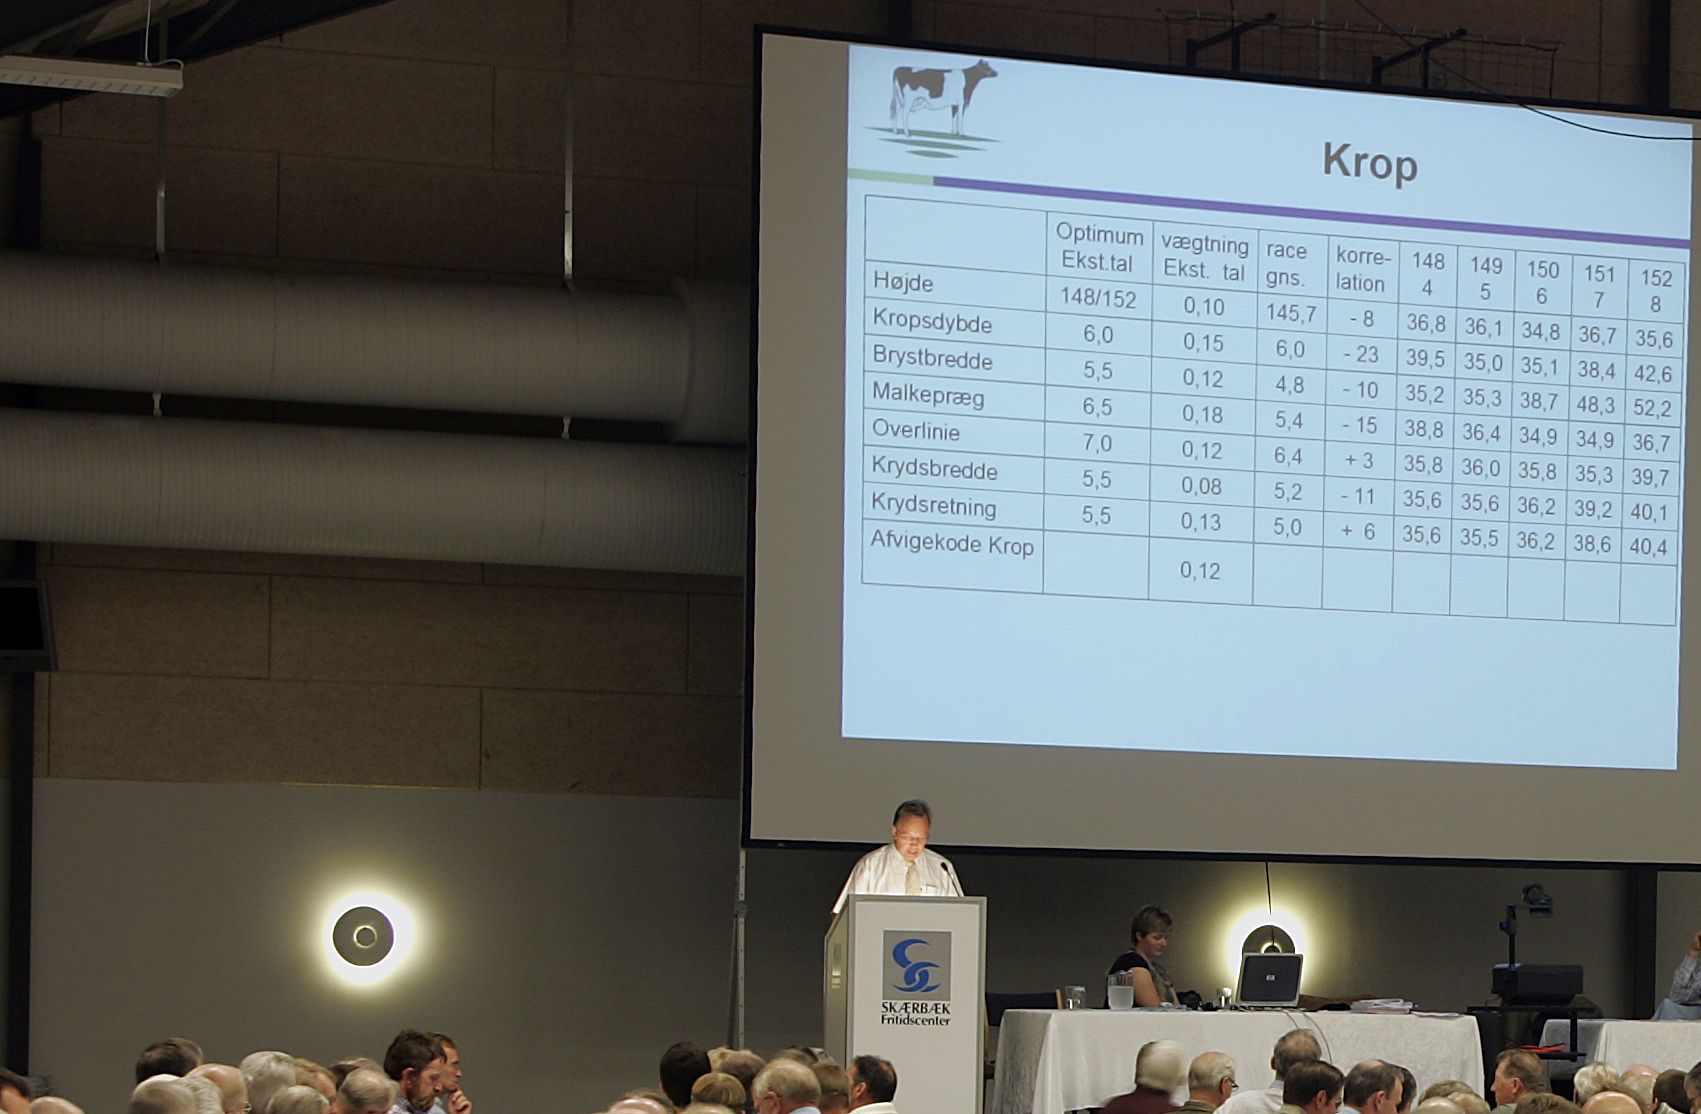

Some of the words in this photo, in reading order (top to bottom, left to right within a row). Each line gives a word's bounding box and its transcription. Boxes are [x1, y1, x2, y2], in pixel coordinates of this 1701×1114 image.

[1323, 141, 1418, 190] Krop
[1056, 221, 1144, 247] Optimum
[1161, 234, 1249, 260] vægtning
[1267, 243, 1308, 260] race
[1336, 244, 1392, 266] korre-
[1413, 251, 1445, 271] 148
[1471, 256, 1503, 275] 149
[1527, 260, 1560, 279] 150
[1584, 264, 1614, 283] 151
[1641, 268, 1673, 288] 152
[1164, 257, 1210, 280] Ekst.
[1222, 263, 1245, 282] tal
[1265, 270, 1305, 289] gns.
[1336, 271, 1385, 293] lation
[1421, 278, 1433, 297] 4
[1480, 282, 1491, 301] 5
[1536, 287, 1548, 305] 6
[1594, 290, 1605, 309] 7
[1650, 295, 1662, 313] 8
[874, 269, 934, 296] Højde
[1061, 286, 1137, 310] 148/152
[1183, 295, 1225, 317] 0,10
[1266, 302, 1317, 325] 145,7
[1362, 309, 1375, 328] 8
[1407, 312, 1446, 335] 36,8
[1464, 316, 1502, 339] 36,1
[1522, 320, 1561, 343] 34,8
[1578, 325, 1617, 347] 36,7
[1635, 329, 1674, 351] 35,6
[873, 306, 993, 336] Kropsdybde
[1083, 323, 1114, 346] 6,0
[1183, 331, 1224, 353] 0,15
[1276, 339, 1305, 361] 6,0
[1356, 344, 1379, 364] 23
[1406, 348, 1446, 370] 39,5
[1464, 352, 1504, 374] 35,0
[1521, 356, 1557, 378] 35,1
[1578, 360, 1617, 382] 38,4
[1634, 364, 1673, 385] 42,6
[873, 343, 993, 371] Brystbredde
[1083, 360, 1113, 382] 5,5
[1182, 367, 1224, 390] 0,12
[1275, 375, 1305, 396] 4,8
[1357, 380, 1379, 399] 10
[1405, 383, 1445, 406] 35,2
[1463, 387, 1502, 409] 35,3
[1520, 391, 1559, 413] 38,7
[1576, 395, 1615, 417] 48,3
[1633, 398, 1672, 420] 52,2
[873, 380, 985, 412] Malkepræg
[1082, 396, 1113, 419] 6,5
[1182, 403, 1223, 425] 0,18
[1275, 410, 1303, 432] 5,4
[1357, 416, 1378, 435] 15
[1404, 418, 1444, 441] 38,8
[1462, 422, 1501, 444] 36,4
[1519, 425, 1558, 448] 34,9
[1576, 429, 1615, 451] 34,9
[1632, 433, 1671, 454] 36,7
[872, 417, 961, 442] Overlinie
[1083, 432, 1113, 455] 7,0
[1182, 440, 1222, 461] 0,12
[1274, 446, 1303, 467] 6,4
[1362, 451, 1374, 470] 3
[1403, 454, 1443, 476] 35,8
[1461, 457, 1501, 480] 36,0
[1518, 460, 1557, 482] 35,8
[1575, 464, 1614, 486] 35,3
[1631, 467, 1670, 489] 39,7
[872, 454, 999, 481] Krydsbredde
[1082, 469, 1112, 491] 5,5
[1181, 475, 1222, 497] 0,08
[1274, 481, 1303, 503] 5,2
[1356, 486, 1374, 505] 11
[1402, 489, 1442, 511] 35,6
[1460, 492, 1500, 514] 35,6
[1517, 495, 1556, 517] 36,2
[1574, 499, 1613, 521] 39,2
[1630, 502, 1667, 523] 40,1
[870, 528, 982, 554] Afvigekode
[988, 535, 1035, 561] Krop
[1180, 560, 1221, 582] 0,12
[872, 491, 997, 522] Krydsretning
[1082, 505, 1112, 527] 5,5
[1181, 511, 1222, 533] 0,13
[1273, 516, 1302, 539] 5,0
[1364, 522, 1376, 541] 6
[1402, 524, 1442, 546] 35,6
[1460, 527, 1499, 549] 35,5
[1516, 530, 1555, 552] 36,2
[1573, 533, 1612, 555] 38,6
[1629, 537, 1668, 559] 40,4
[881, 1001, 951, 1014] SKÆRBÆK
[881, 1014, 951, 1026] Fritidscenter
